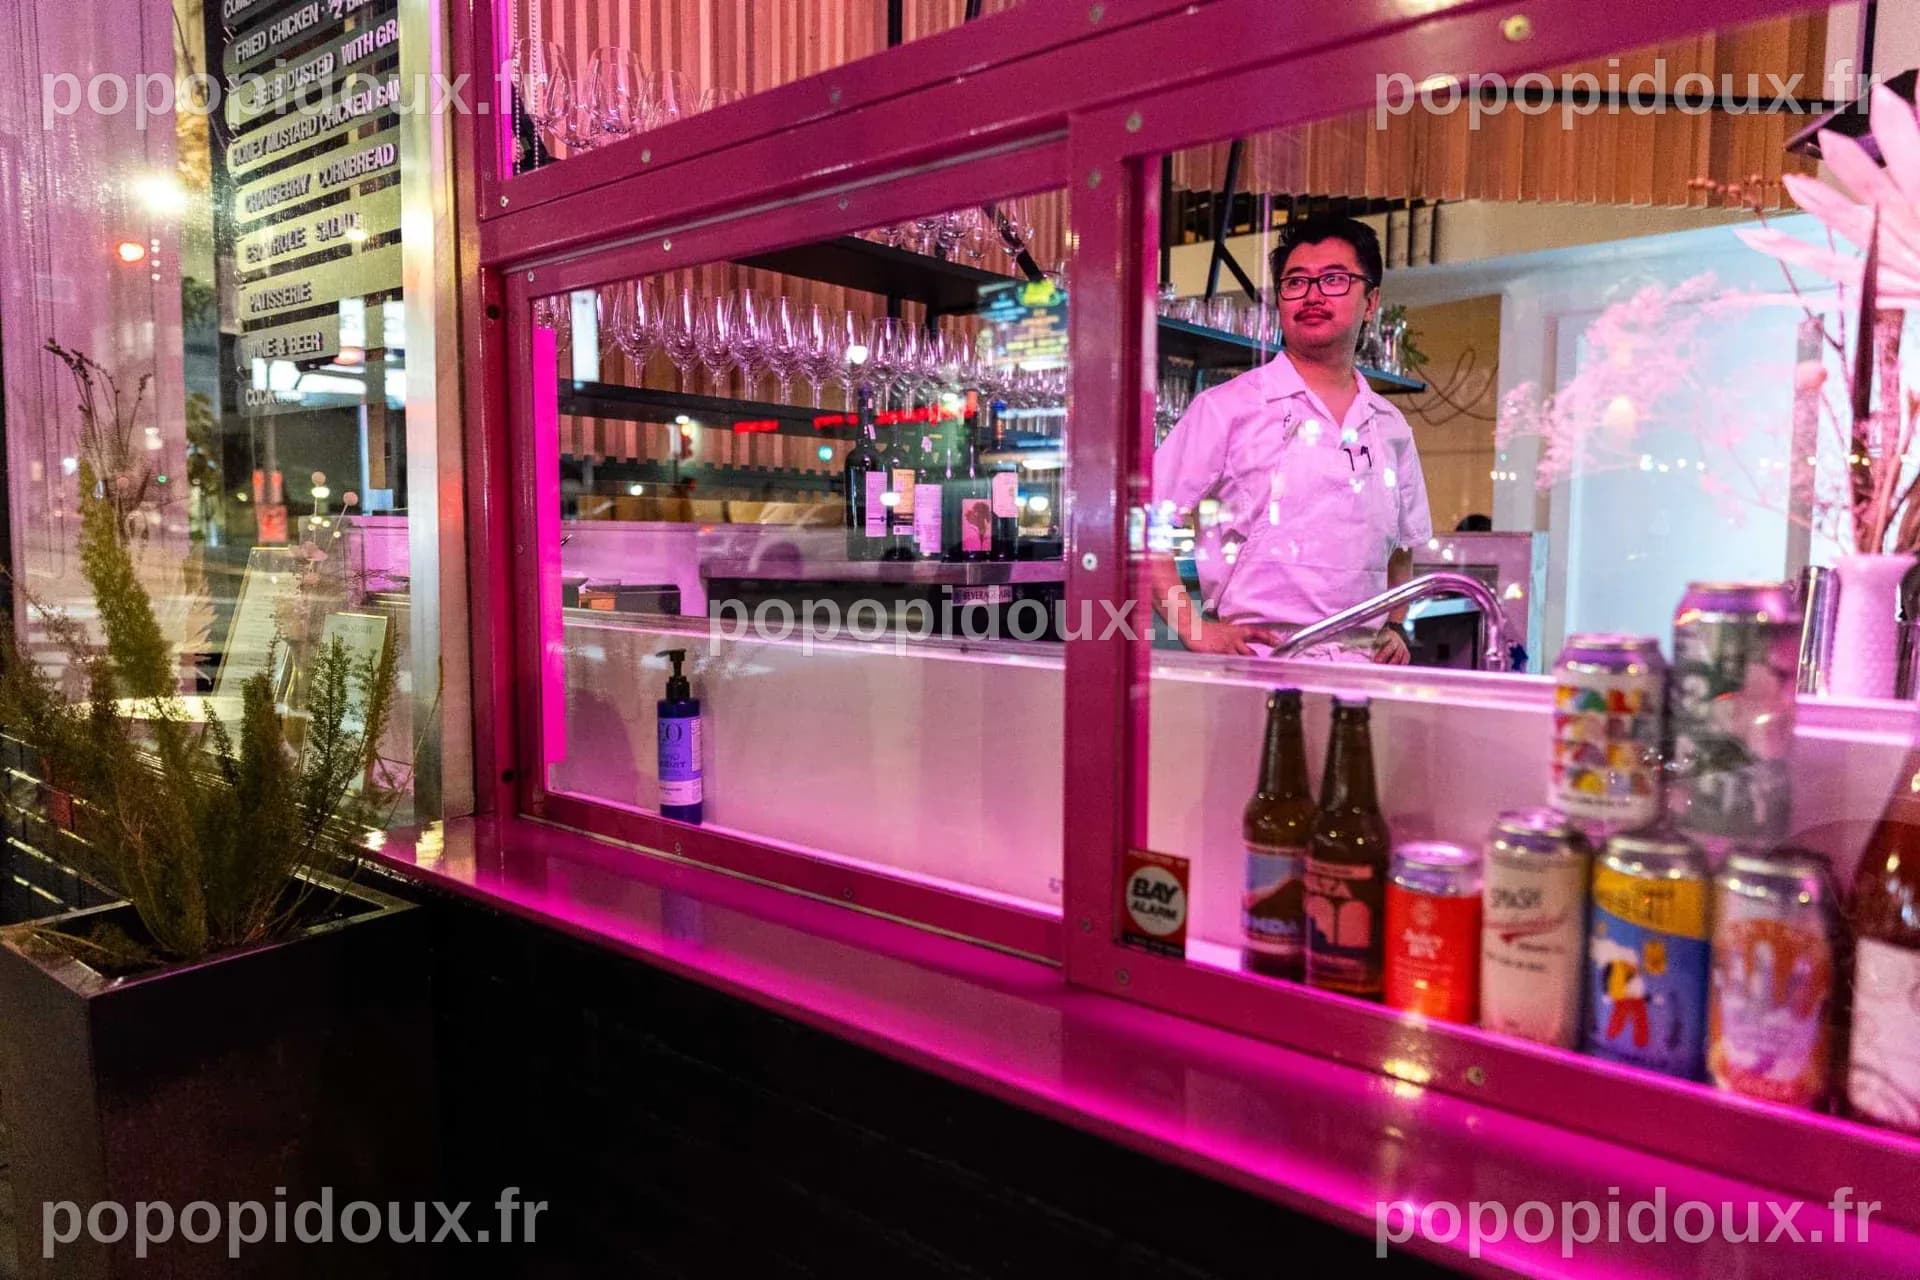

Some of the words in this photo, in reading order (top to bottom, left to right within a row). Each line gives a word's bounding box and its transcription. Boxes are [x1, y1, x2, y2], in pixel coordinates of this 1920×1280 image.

[235, 31, 267, 63] FRIED
[269, 2, 319, 45] CHICKEN
[253, 78, 284, 108] HERB
[288, 52, 334, 92] DUSTED
[341, 30, 373, 66] WITH
[233, 136, 267, 167] HONEY
[267, 116, 319, 154] MUSTARD
[320, 91, 373, 131] CHICKEN
[246, 174, 311, 213] CRANBERRY
[318, 143, 396, 189] CORNBREAD
[249, 282, 312, 313] PATISSERIE
[290, 331, 323, 356] BEER
[1131, 900, 1178, 921] ALARM
[1132, 877, 1179, 905] BAY
